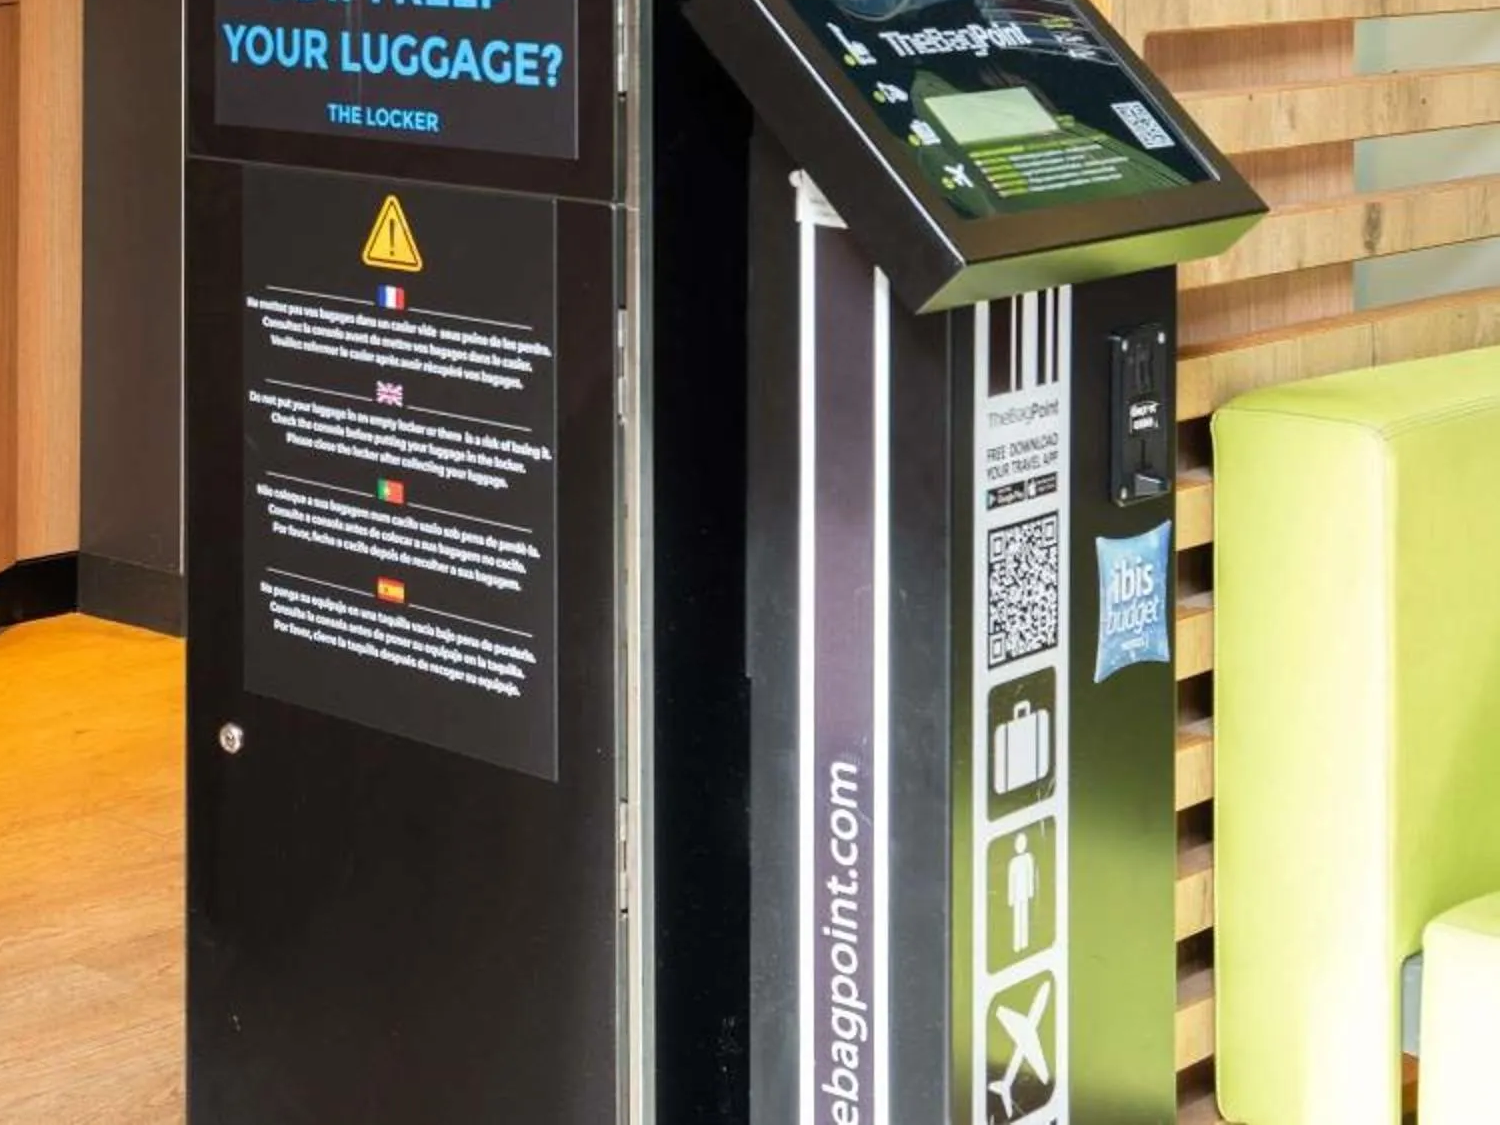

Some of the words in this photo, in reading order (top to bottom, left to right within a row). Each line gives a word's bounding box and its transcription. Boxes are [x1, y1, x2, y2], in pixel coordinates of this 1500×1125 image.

[223, 24, 328, 70] YOUR
[341, 31, 563, 87] LUGGAGE?
[879, 23, 1033, 58] TheBagPoint
[327, 103, 361, 125] THE
[366, 106, 439, 132] LOCKER
[988, 400, 1059, 428] TheBagPoint
[987, 445, 1007, 462] FREE
[1010, 432, 1059, 457] DOWNLOAD
[987, 464, 1009, 481] YOUR
[1043, 451, 1059, 465] APP
[1112, 556, 1154, 603] ibis
[1106, 594, 1160, 636] budget
